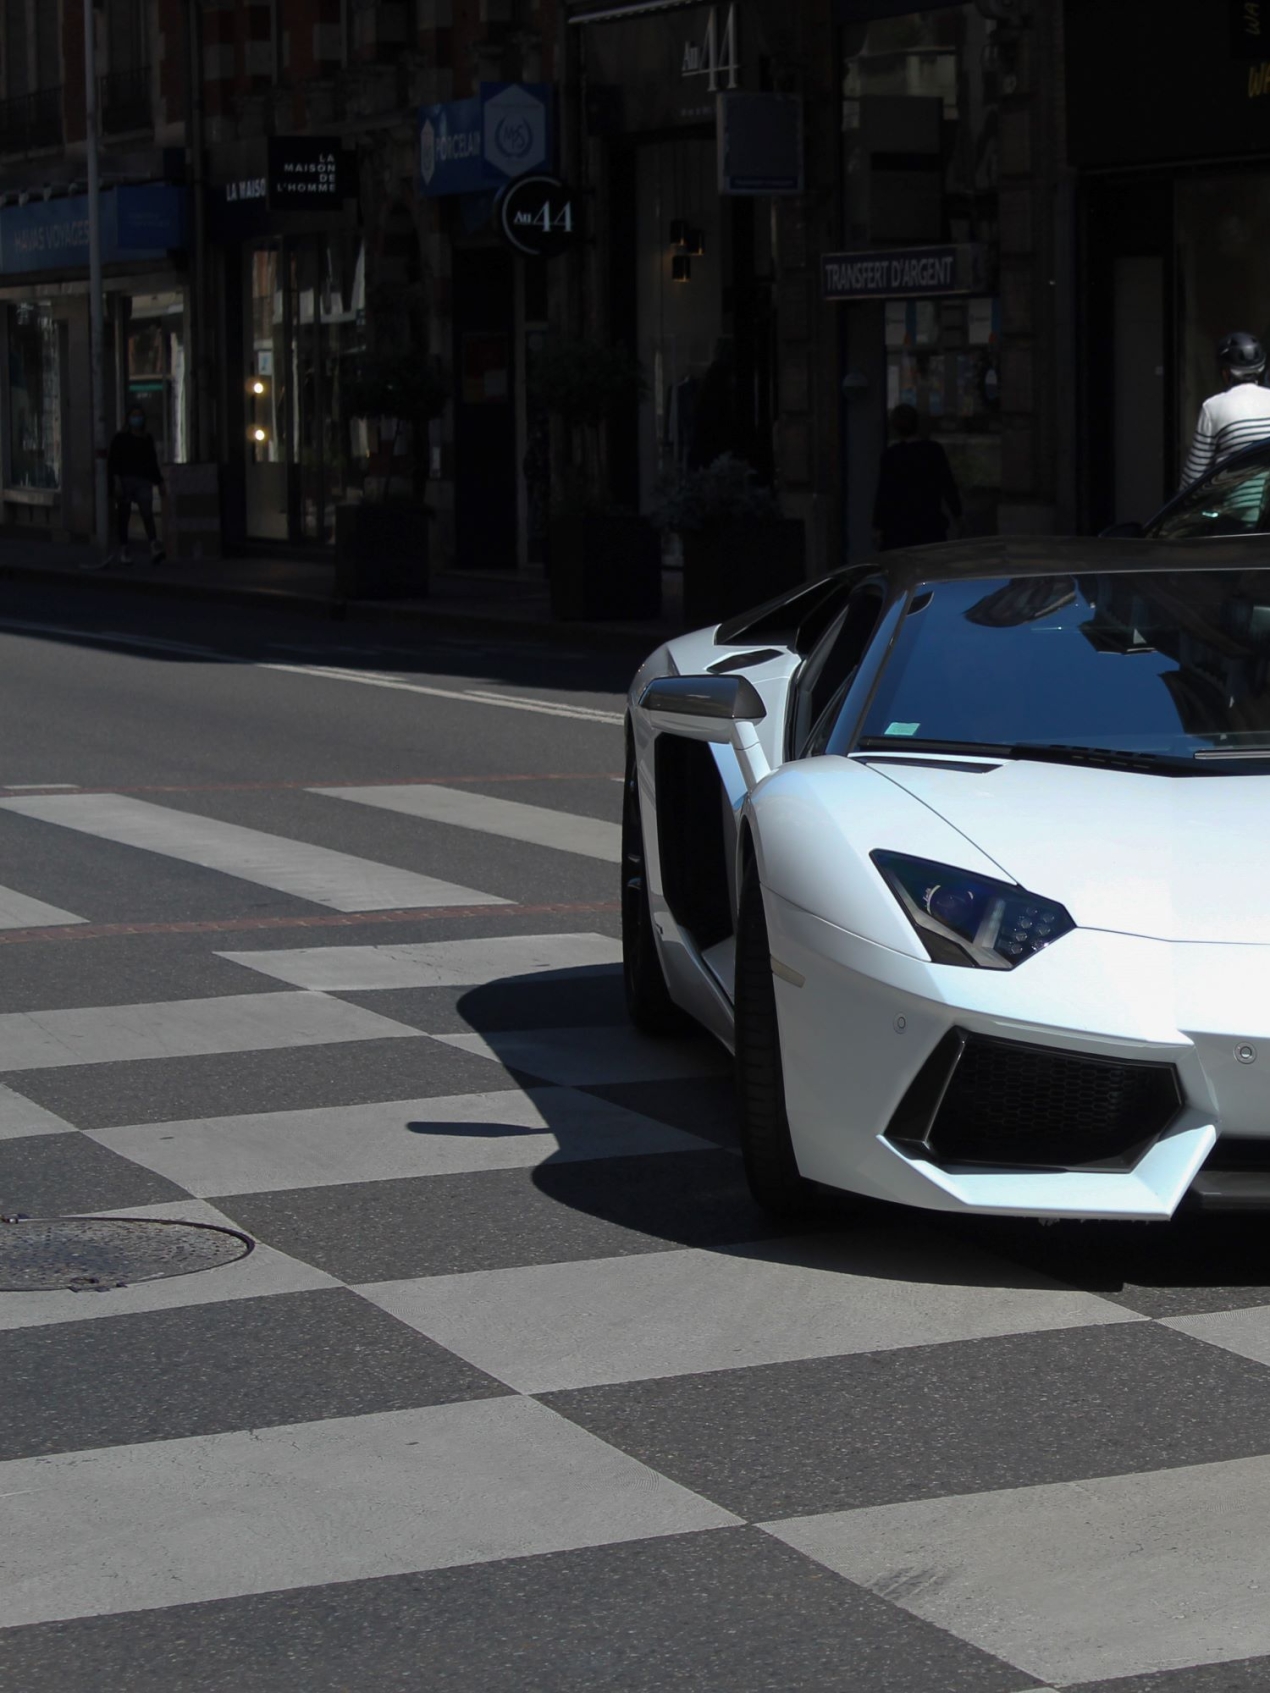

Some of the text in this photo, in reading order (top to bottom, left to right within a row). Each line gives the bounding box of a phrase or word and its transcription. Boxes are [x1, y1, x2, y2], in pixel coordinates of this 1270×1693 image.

[699, 2, 740, 91] 44
[319, 153, 335, 163] LA
[283, 163, 336, 173] MAISON
[319, 173, 336, 183] DE
[226, 182, 237, 202] LA
[276, 183, 336, 192] L'HOMME
[533, 200, 574, 233] 44
[825, 256, 954, 291] TRANSFERT D'ARGENT
